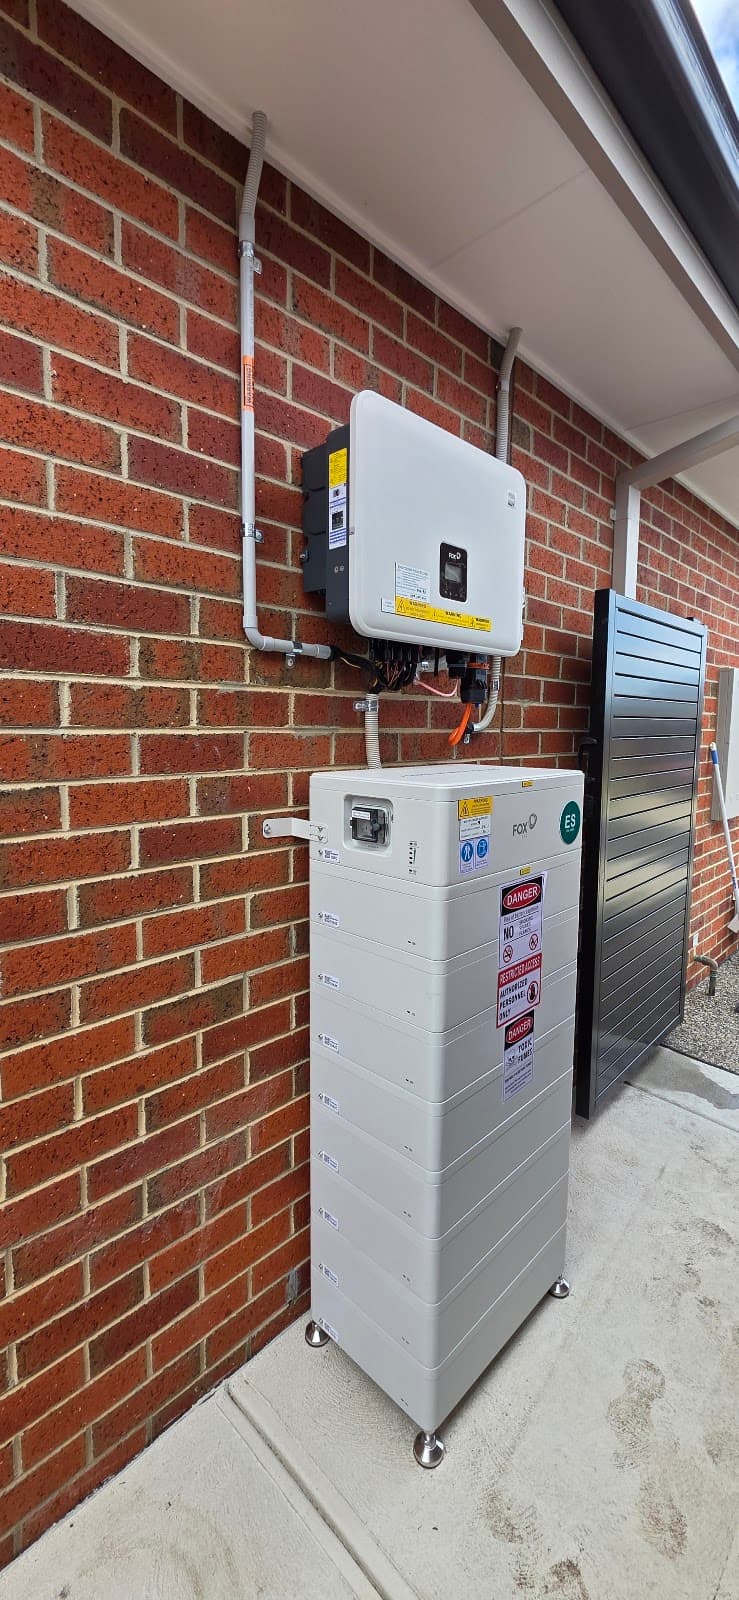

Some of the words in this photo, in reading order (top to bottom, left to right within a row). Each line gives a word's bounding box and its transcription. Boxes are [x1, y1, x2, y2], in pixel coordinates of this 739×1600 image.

[512, 822, 528, 837] FOX
[564, 813, 576, 829] ES
[507, 886, 538, 906] DANGER
[504, 925, 514, 941] NO
[500, 963, 525, 985] RESTRICTED
[525, 956, 541, 973] ACCESS
[500, 978, 528, 999] AUTHORIZED
[500, 990, 526, 1010] PERSONNEL
[500, 1008, 511, 1021] ONLY
[508, 1019, 531, 1041] DANGER
[517, 1047, 533, 1064] FUMES
